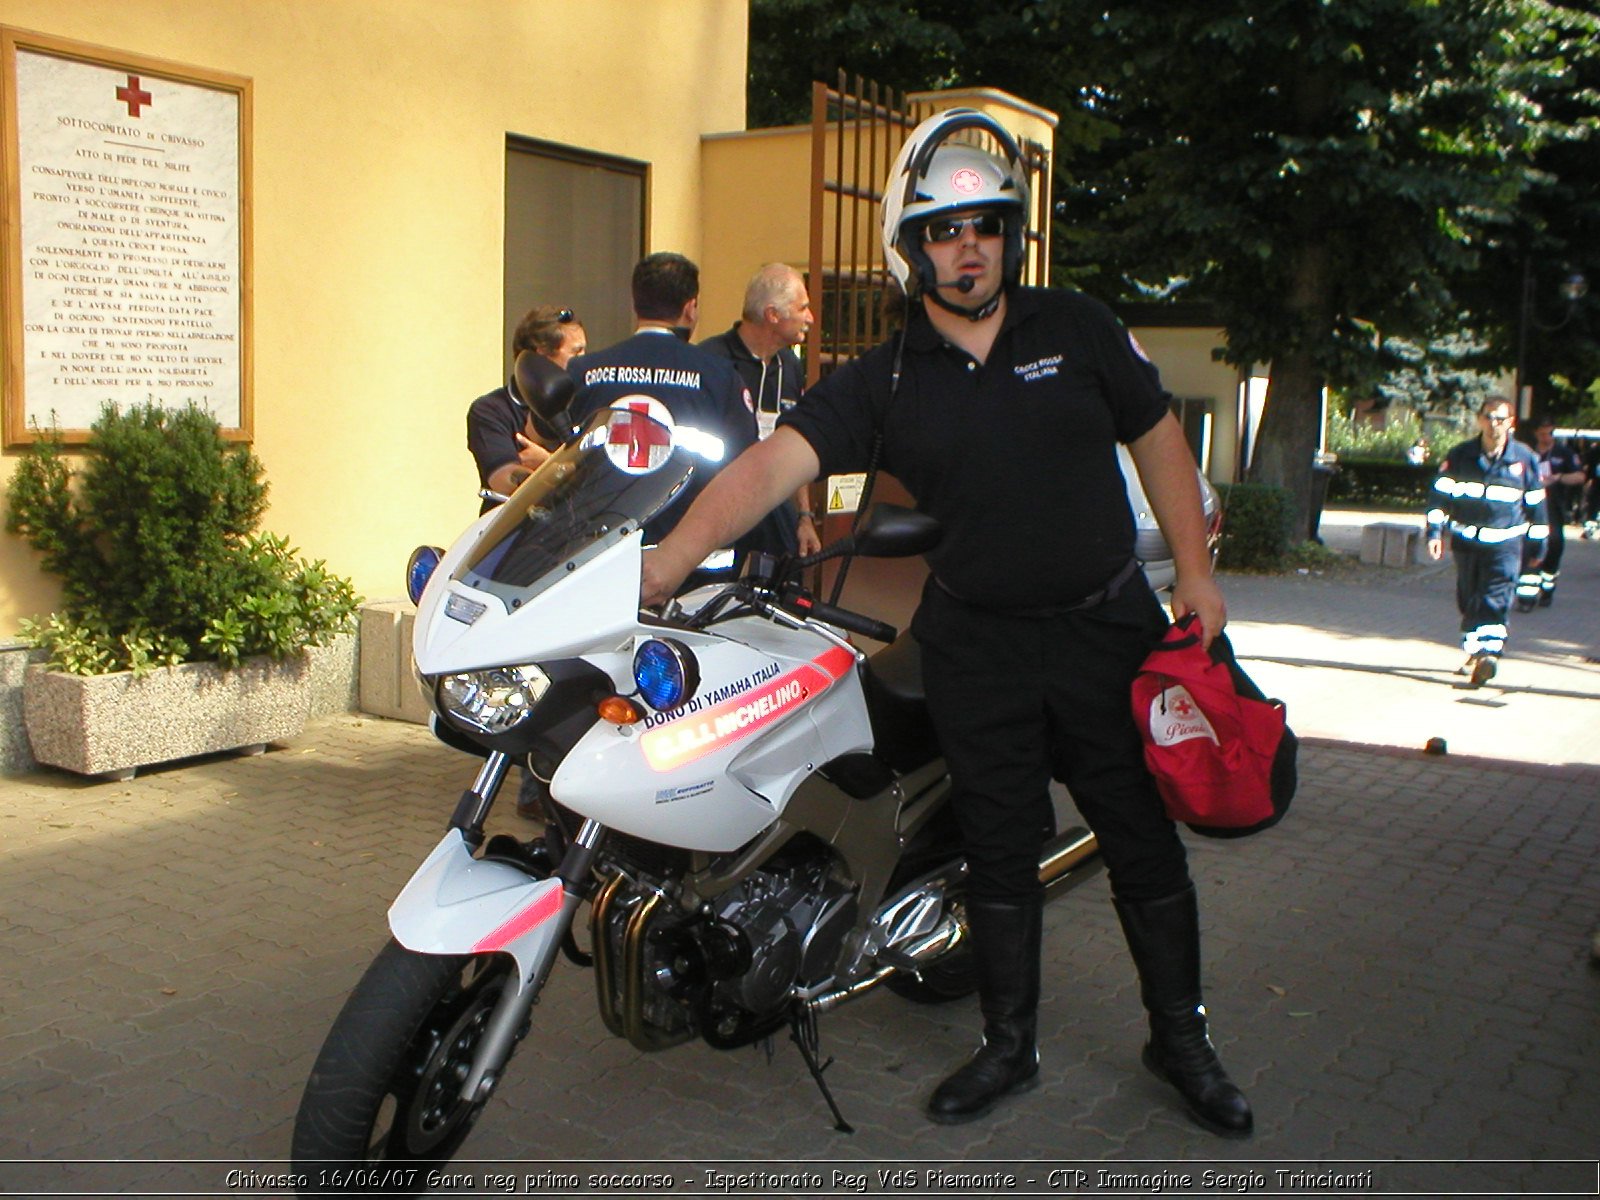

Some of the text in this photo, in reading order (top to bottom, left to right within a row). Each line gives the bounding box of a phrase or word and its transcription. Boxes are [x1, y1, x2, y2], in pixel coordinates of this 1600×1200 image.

[57, 116, 140, 138] SOTTOCOMITATO
[161, 134, 205, 147] CHIVASSO
[74, 149, 99, 159] ATTO
[117, 155, 136, 165] FEDE
[143, 159, 158, 168] DEL
[164, 161, 190, 172] MILITE
[32, 165, 93, 181] CONSAPEVOLE
[99, 174, 155, 189] DELL'IMPEGNO
[159, 182, 189, 194] MORALE
[66, 183, 95, 194] VERSO
[34, 192, 70, 204] PRONTO
[85, 199, 139, 213] SOCCORRERE
[92, 212, 115, 222] MALE
[57, 221, 116, 234] ONORANDOMI
[92, 239, 125, 248] QUESTA
[129, 241, 156, 251] CROCE
[36, 246, 103, 259] SOLENNEMENTE
[30, 258, 49, 267] CON
[48, 273, 70, 282] OGNI
[73, 275, 118, 285] CREATURA
[25, 324, 44, 332] CON
[1014, 362, 1038, 374] CROCE
[1024, 367, 1058, 382] ITALIANA
[585, 367, 700, 389] CROCE ROSSA ITALIANA
[644, 662, 781, 729] DONO DI YAMAHA ITALIA
